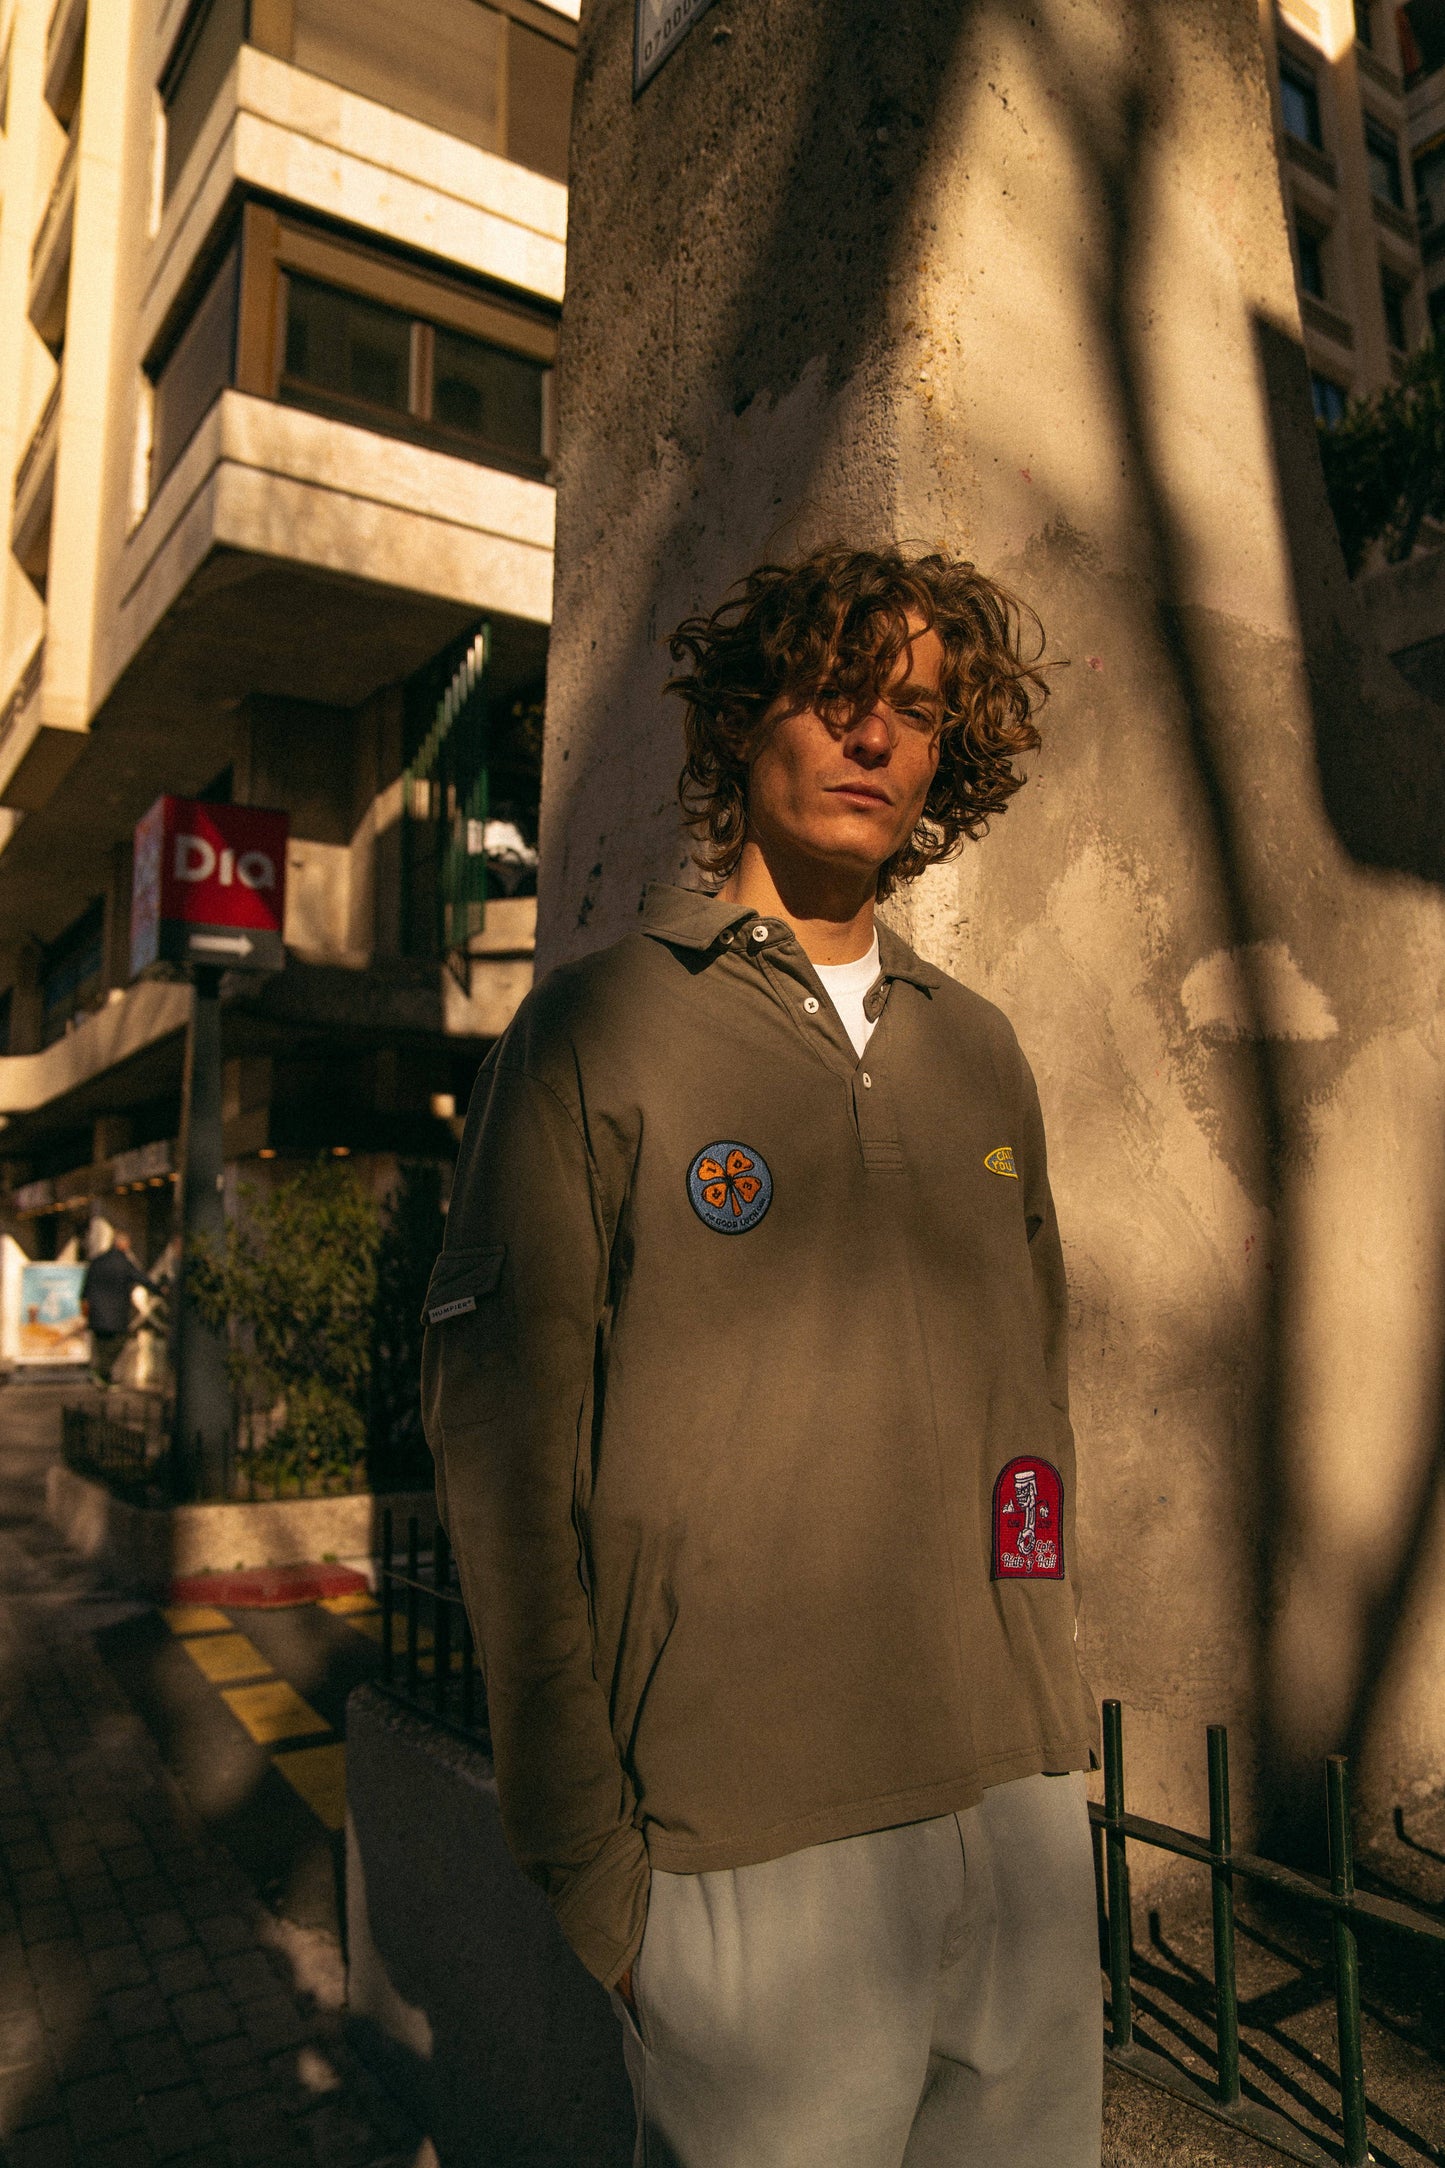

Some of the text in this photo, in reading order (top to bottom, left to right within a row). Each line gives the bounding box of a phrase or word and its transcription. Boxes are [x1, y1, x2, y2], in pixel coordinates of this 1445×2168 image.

[175, 835, 276, 890] Dia
[991, 1161, 1013, 1172] YOU
[716, 1218, 738, 1229] GOOD
[1035, 1539, 1056, 1554] Let's
[1001, 1552, 1025, 1568] Ride
[1035, 1553, 1057, 1569] Roll
